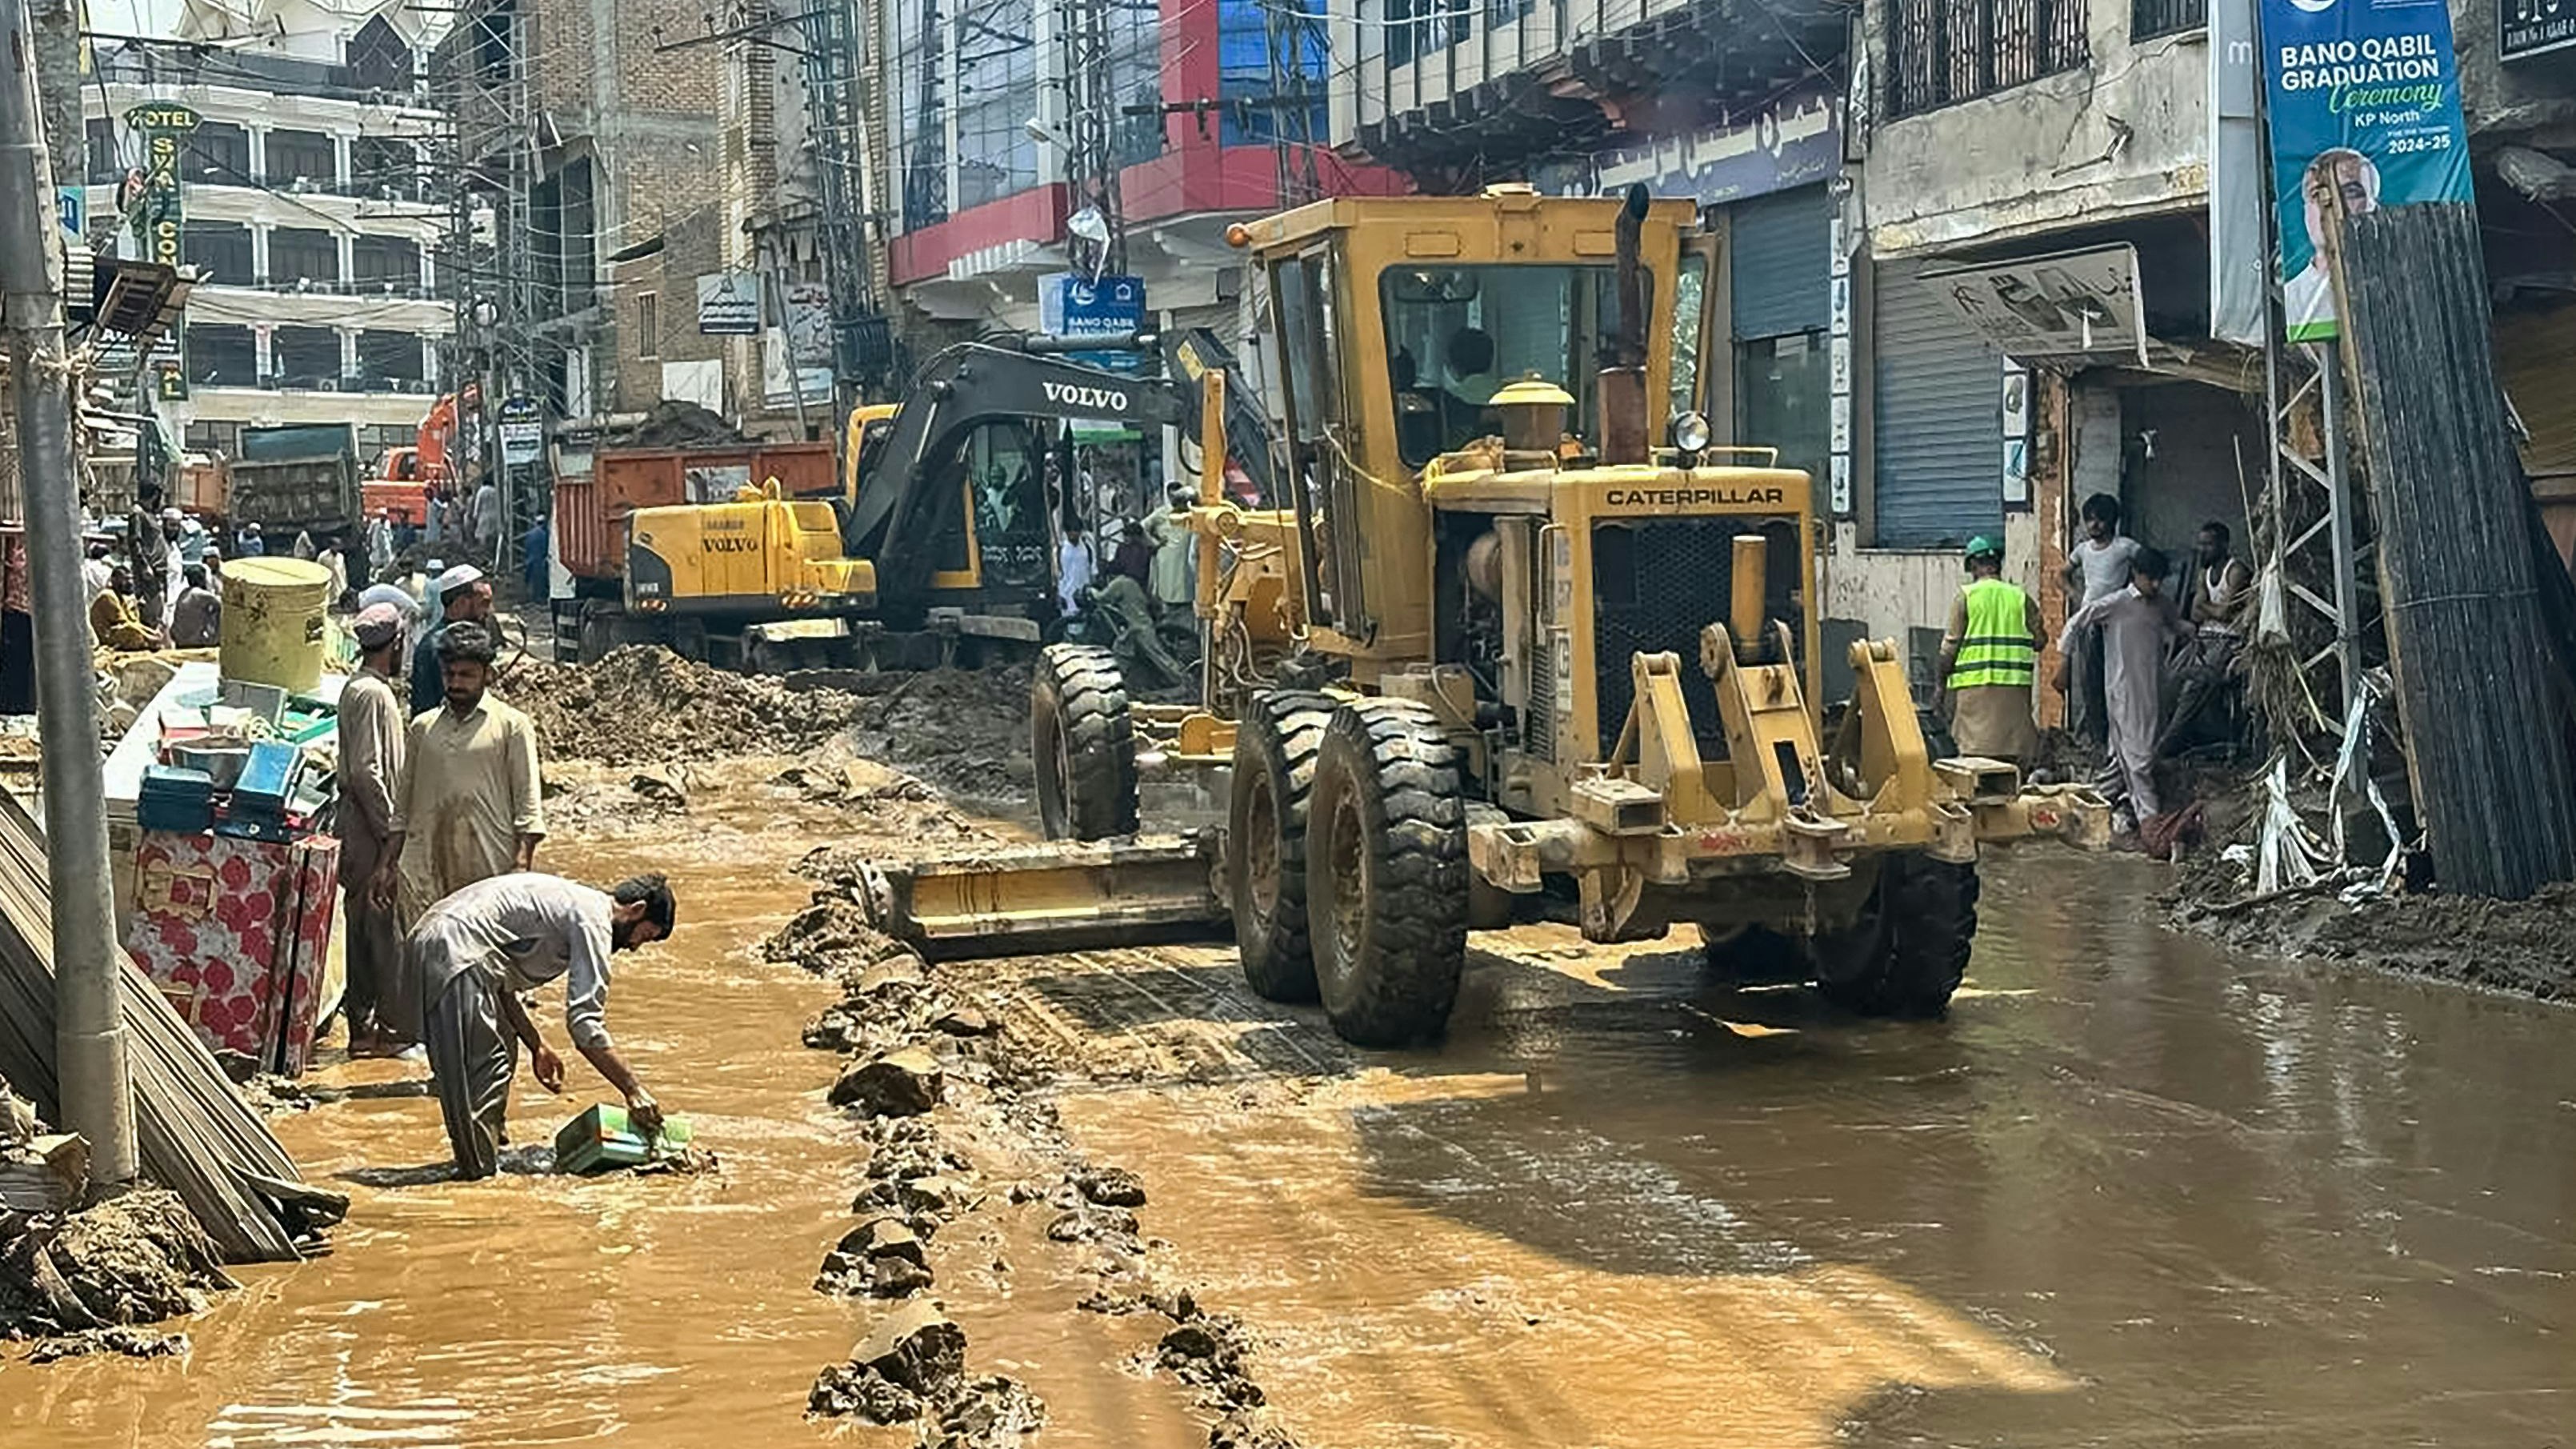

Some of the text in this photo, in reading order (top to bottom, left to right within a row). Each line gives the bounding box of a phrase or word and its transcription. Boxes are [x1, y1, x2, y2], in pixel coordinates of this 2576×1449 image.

[2281, 34, 2436, 69] BANO QABIL
[2281, 57, 2440, 91] GRADUATION
[2328, 80, 2443, 114] Ceremony
[2354, 108, 2421, 128] KP North
[2387, 134, 2451, 154] 2024-25
[1042, 381, 1128, 411] VOLVO
[1606, 487, 1783, 506] CATERPILLAR
[703, 538, 759, 554] VOLVO
